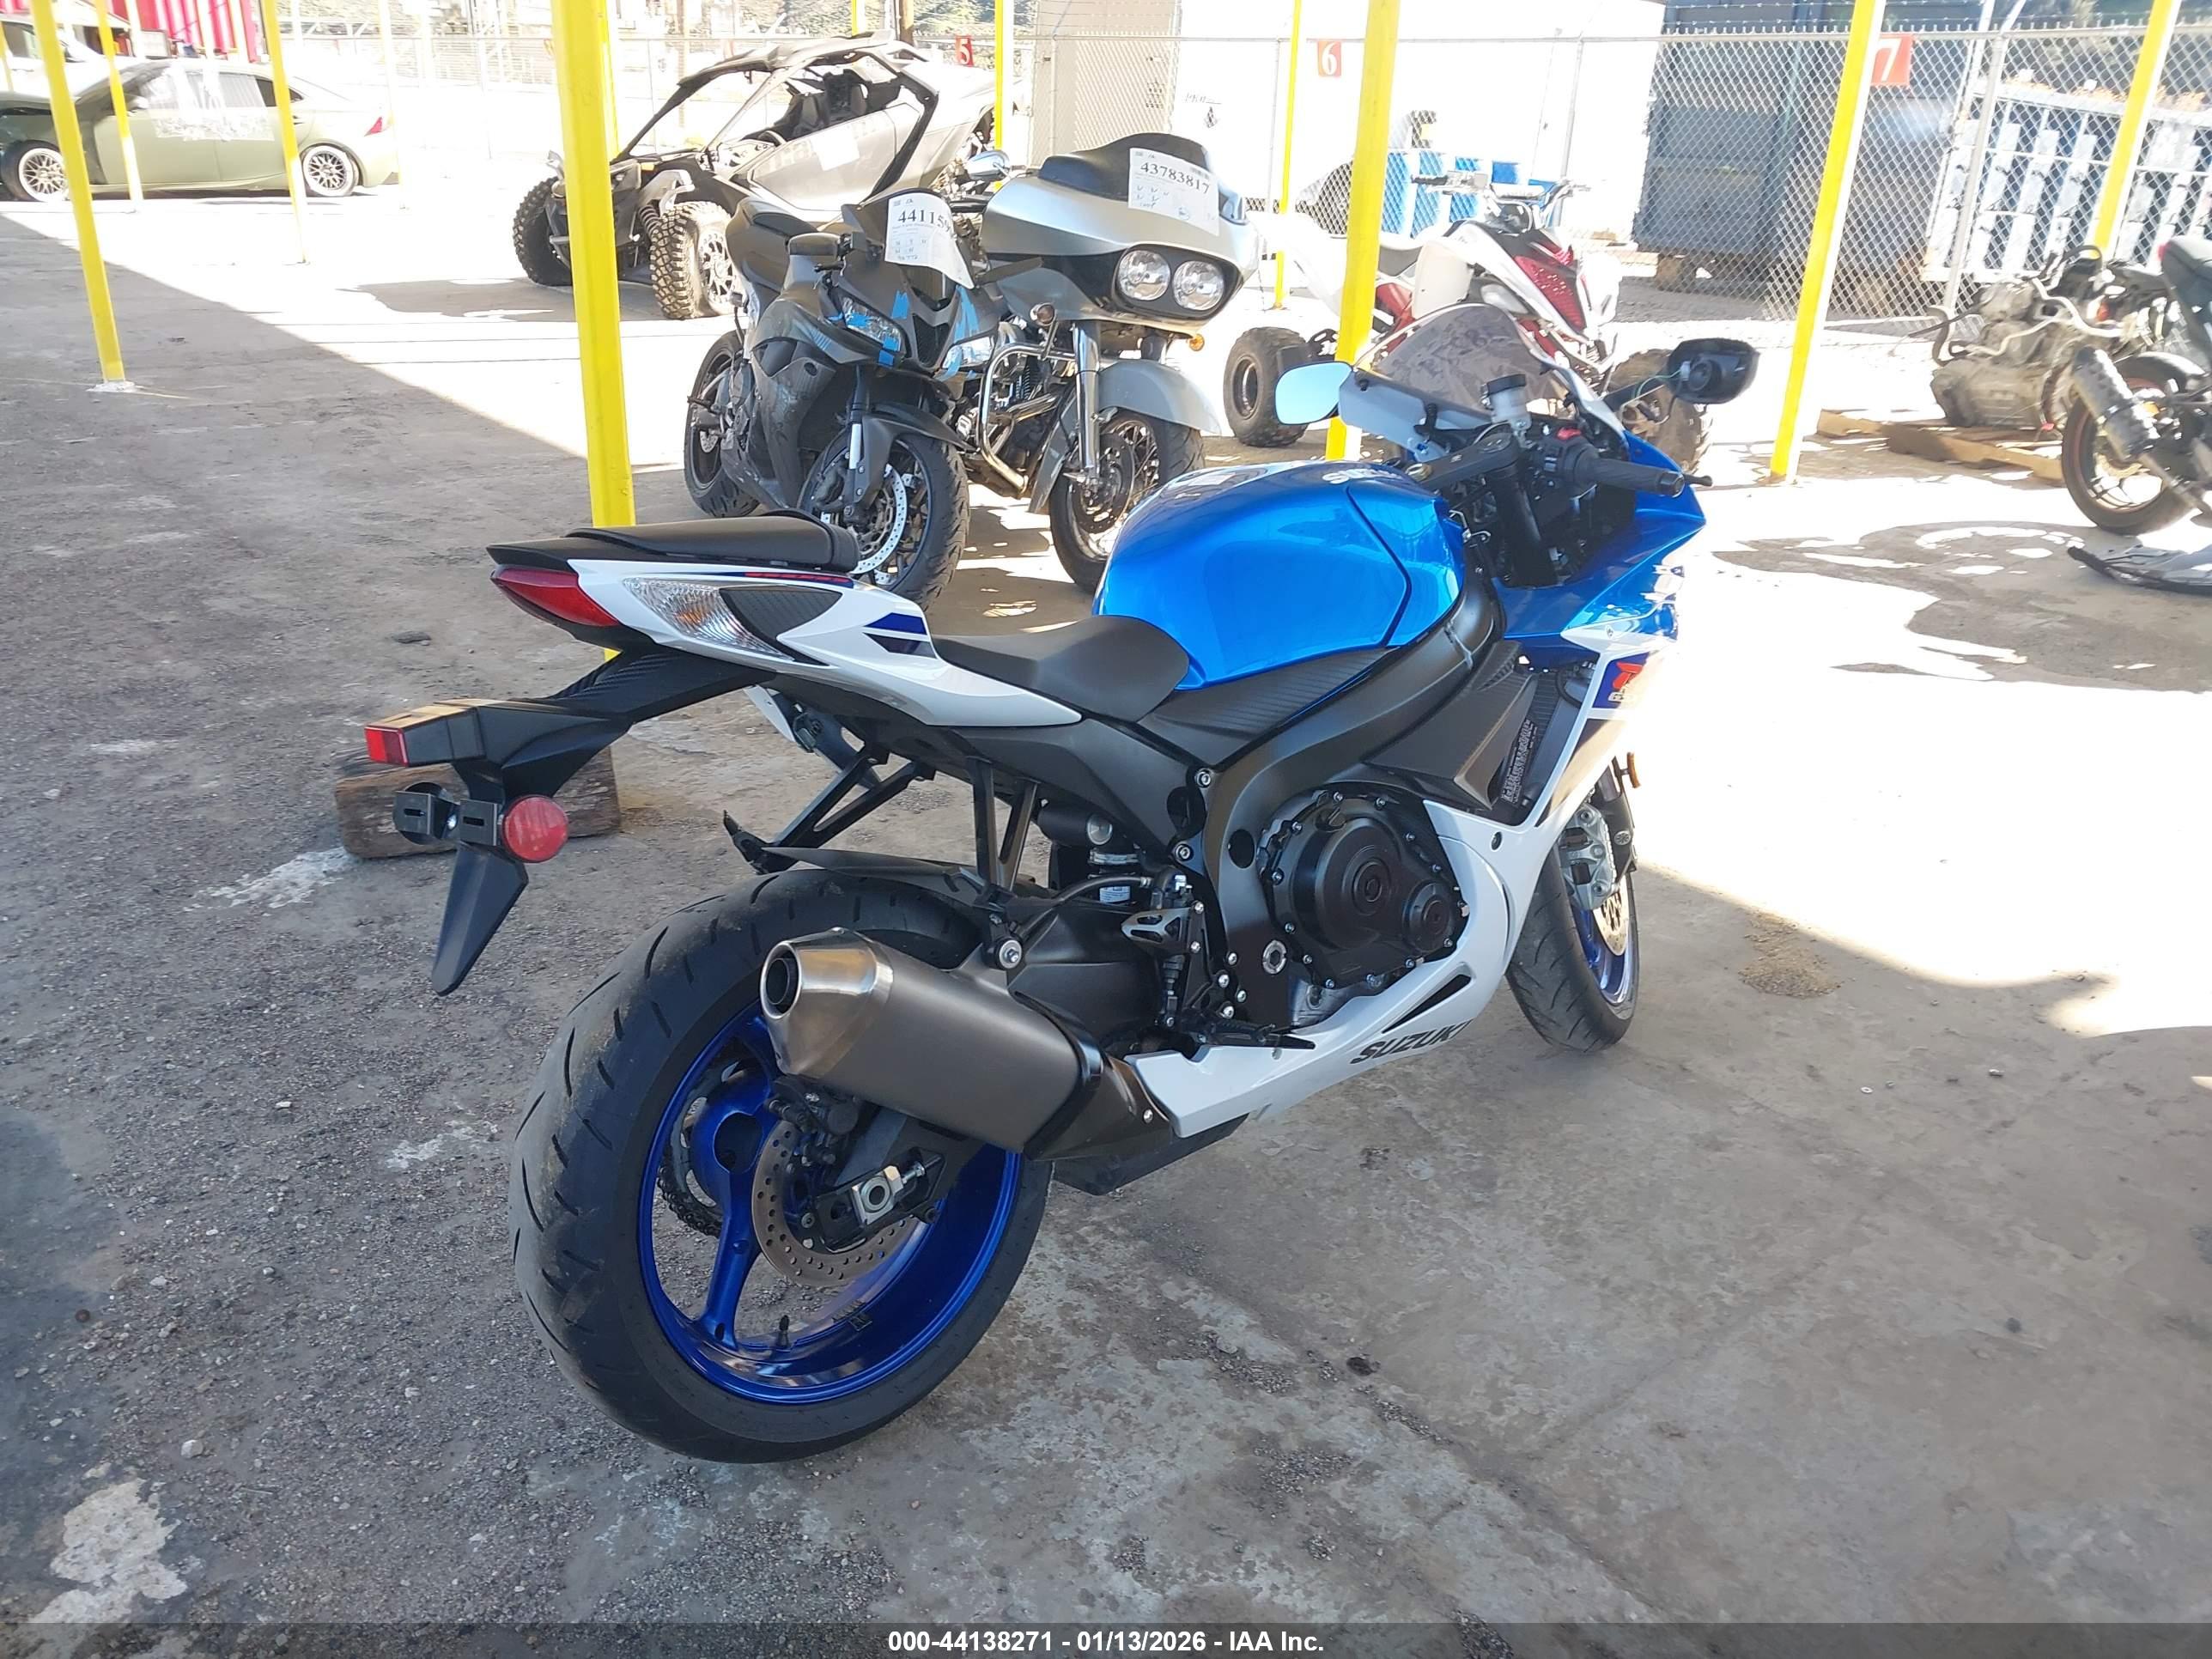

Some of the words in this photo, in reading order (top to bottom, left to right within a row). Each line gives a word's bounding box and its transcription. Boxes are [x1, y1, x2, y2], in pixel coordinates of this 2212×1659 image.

[958, 38, 970, 65] 5
[1322, 41, 1338, 76] 6
[1139, 161, 1210, 194] 43783817
[1350, 1018, 1474, 1065] SUZUKI
